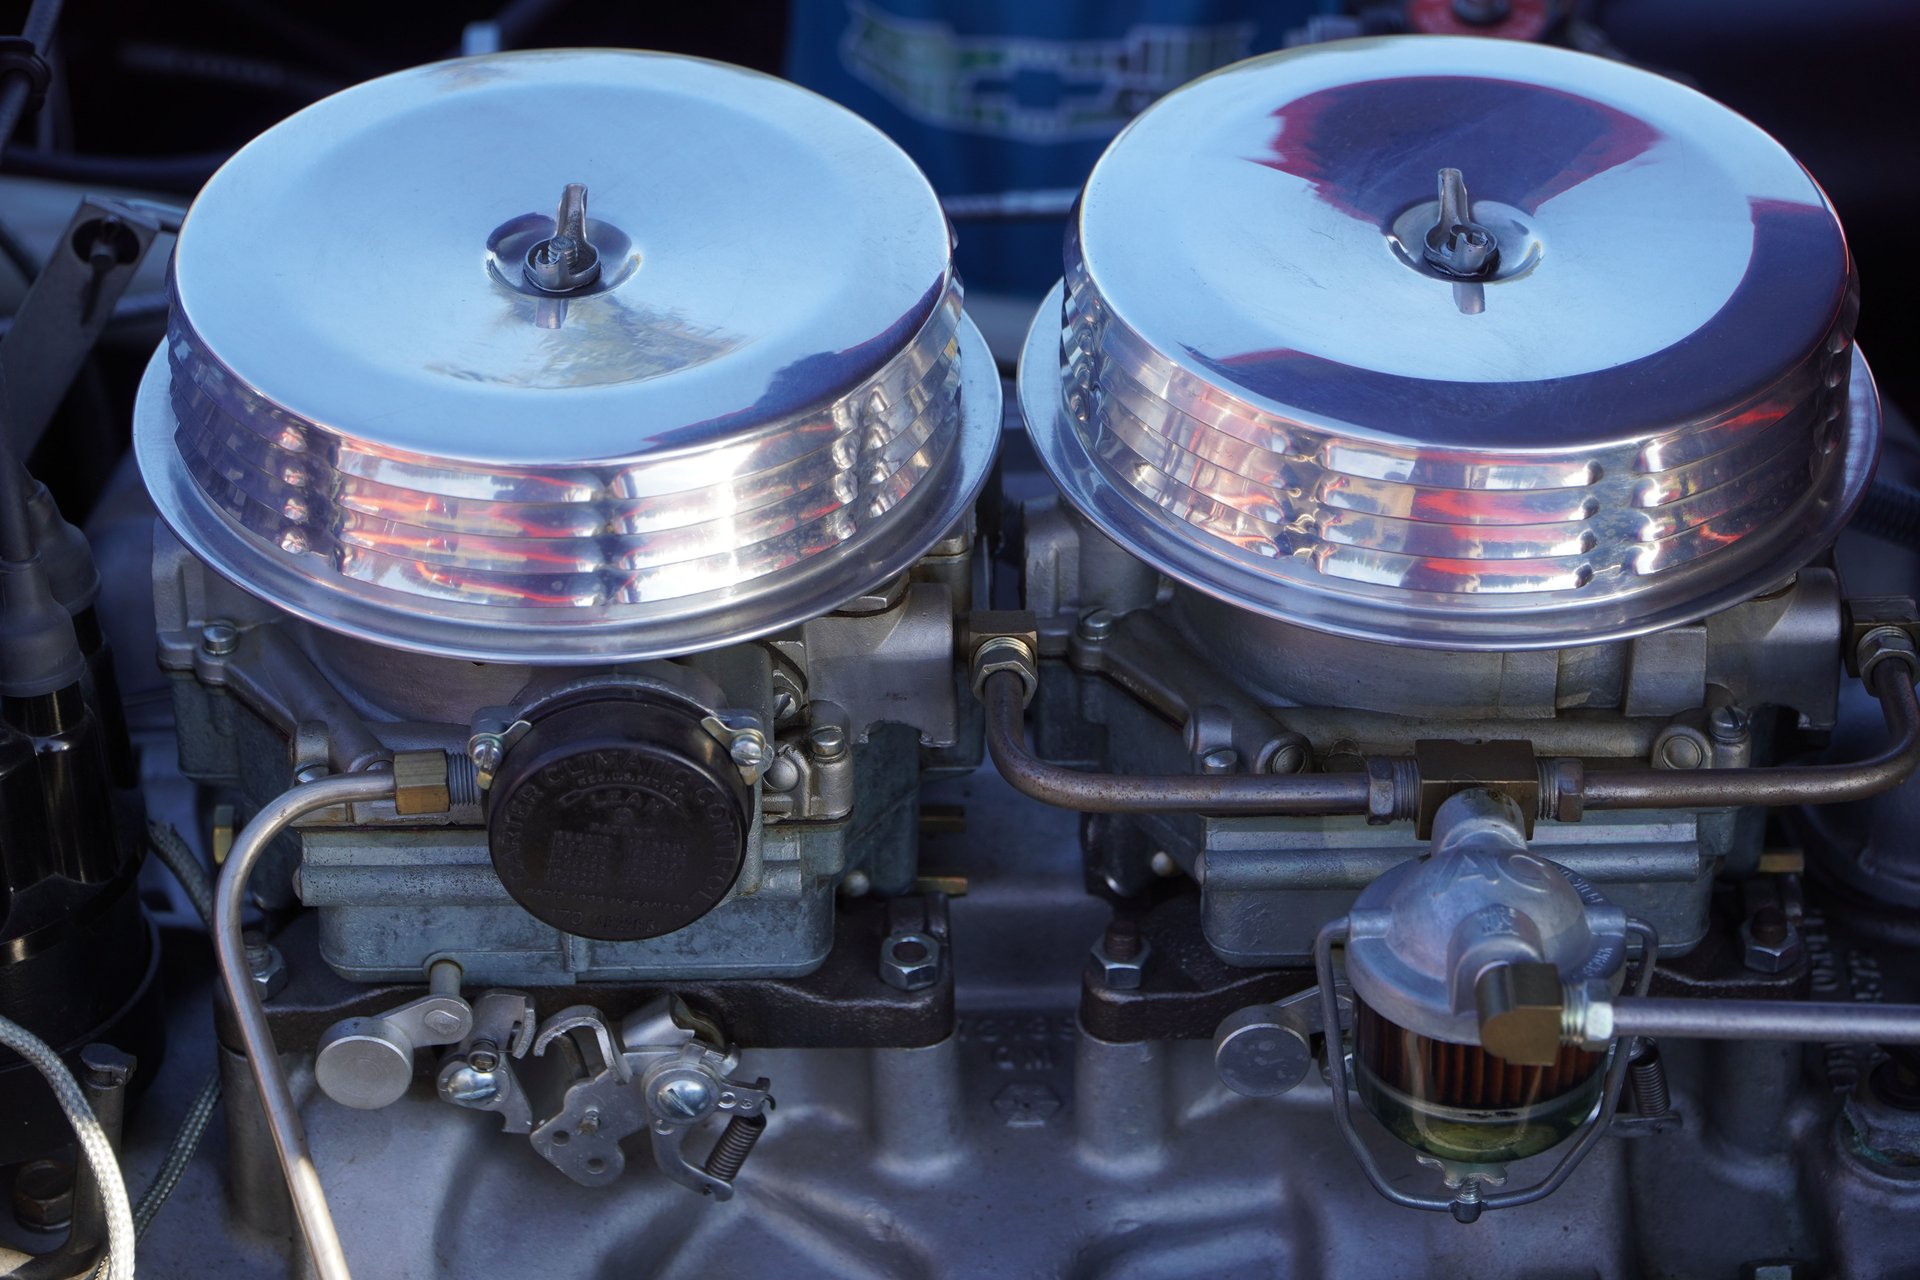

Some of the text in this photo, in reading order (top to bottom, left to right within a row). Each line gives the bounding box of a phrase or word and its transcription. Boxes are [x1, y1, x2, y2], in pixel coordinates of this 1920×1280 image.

[500, 785, 545, 882] CARTER
[545, 752, 690, 788] CLIMATIC
[694, 787, 737, 900] CONTROL
